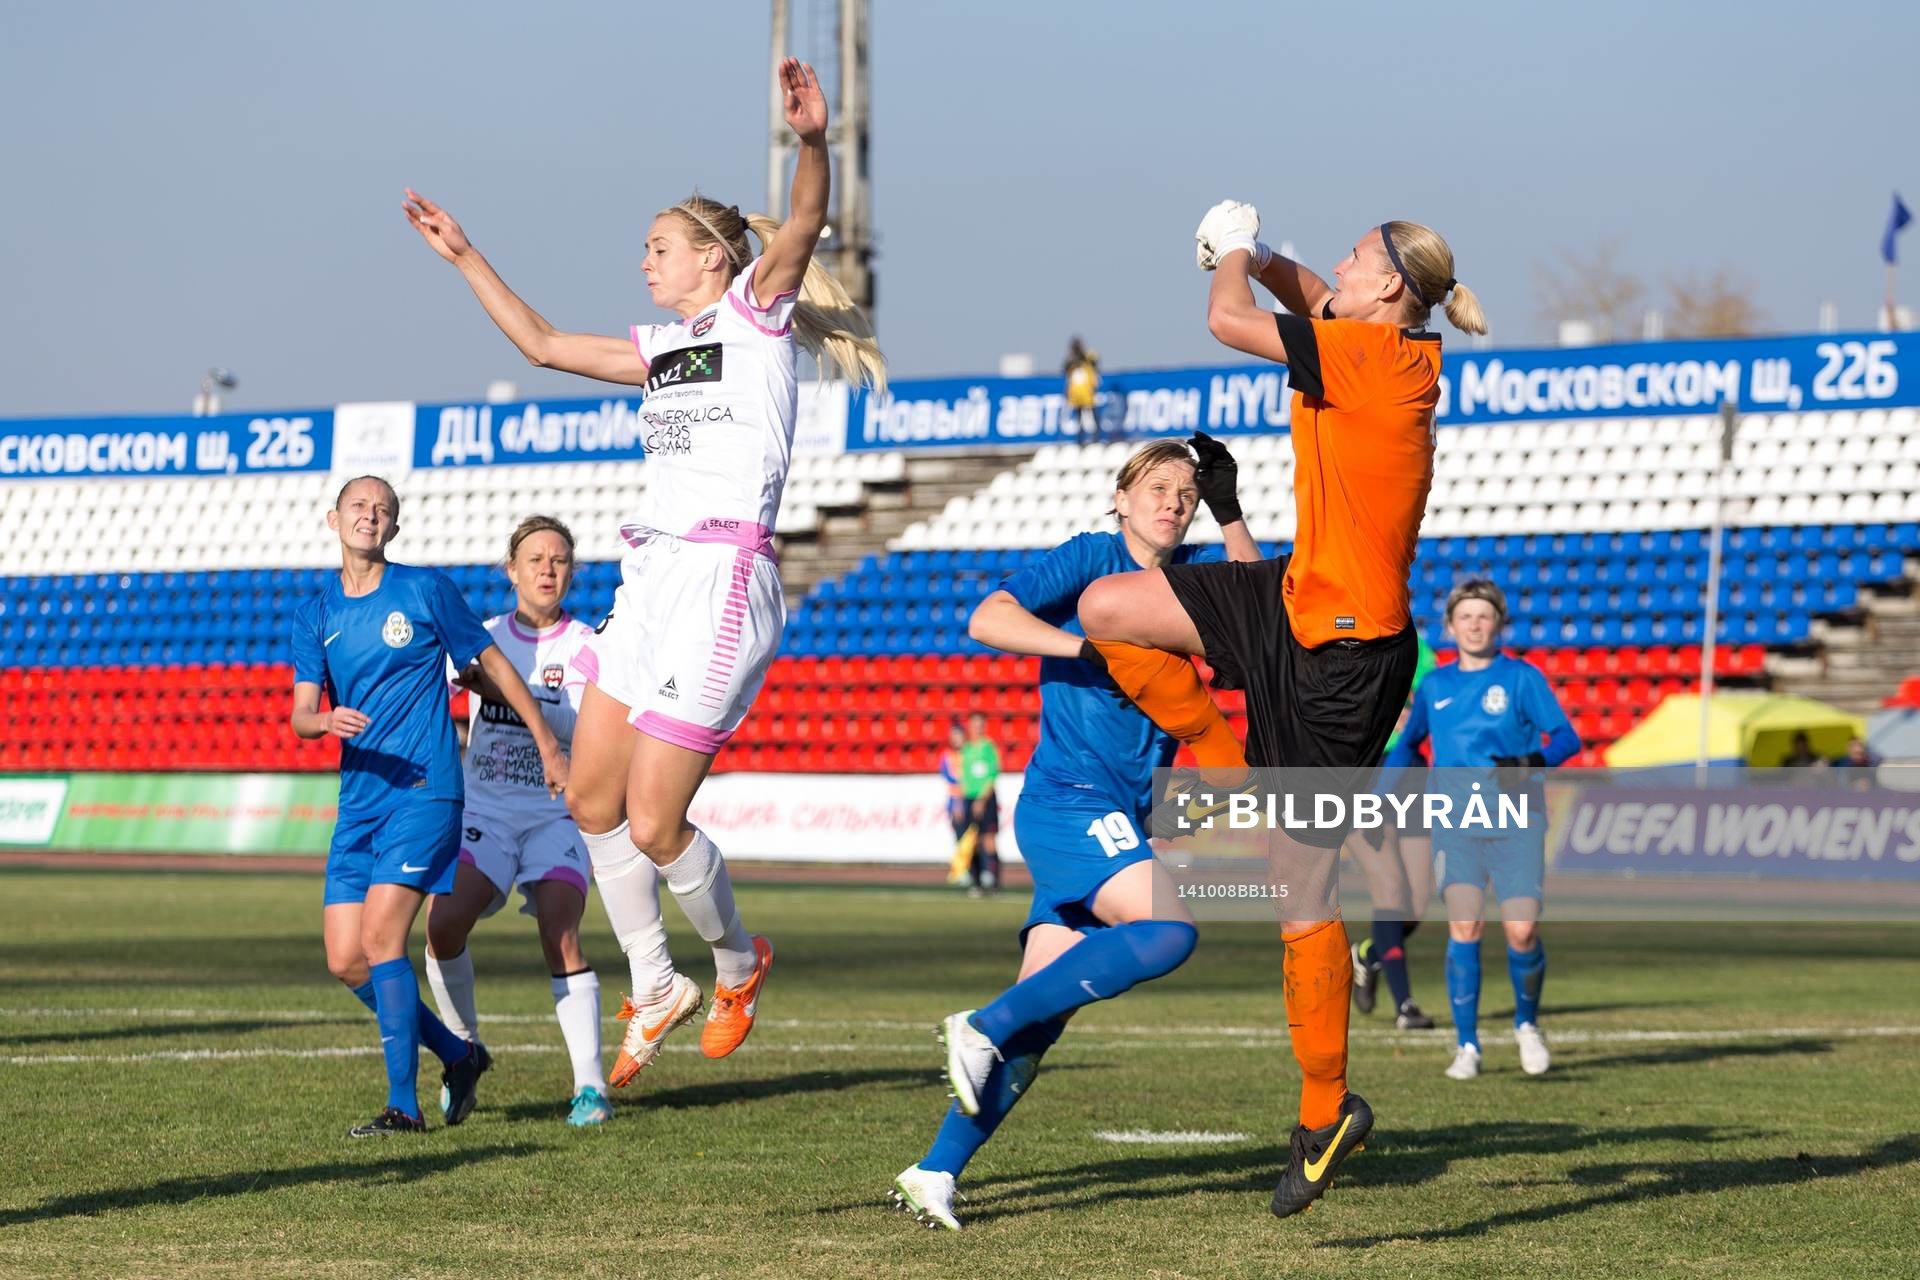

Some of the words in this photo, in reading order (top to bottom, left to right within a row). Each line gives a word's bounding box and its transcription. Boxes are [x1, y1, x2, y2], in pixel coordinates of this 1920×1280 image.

[1460, 357, 1742, 417] Московском
[431, 405, 495, 465] ДЦ
[709, 519, 740, 530] SELECT
[658, 688, 680, 701] SELECT
[465, 826, 482, 842] 9
[1086, 811, 1140, 858] 19
[1570, 802, 1698, 855] UEFA
[1703, 803, 1920, 863] WOMEN'S
